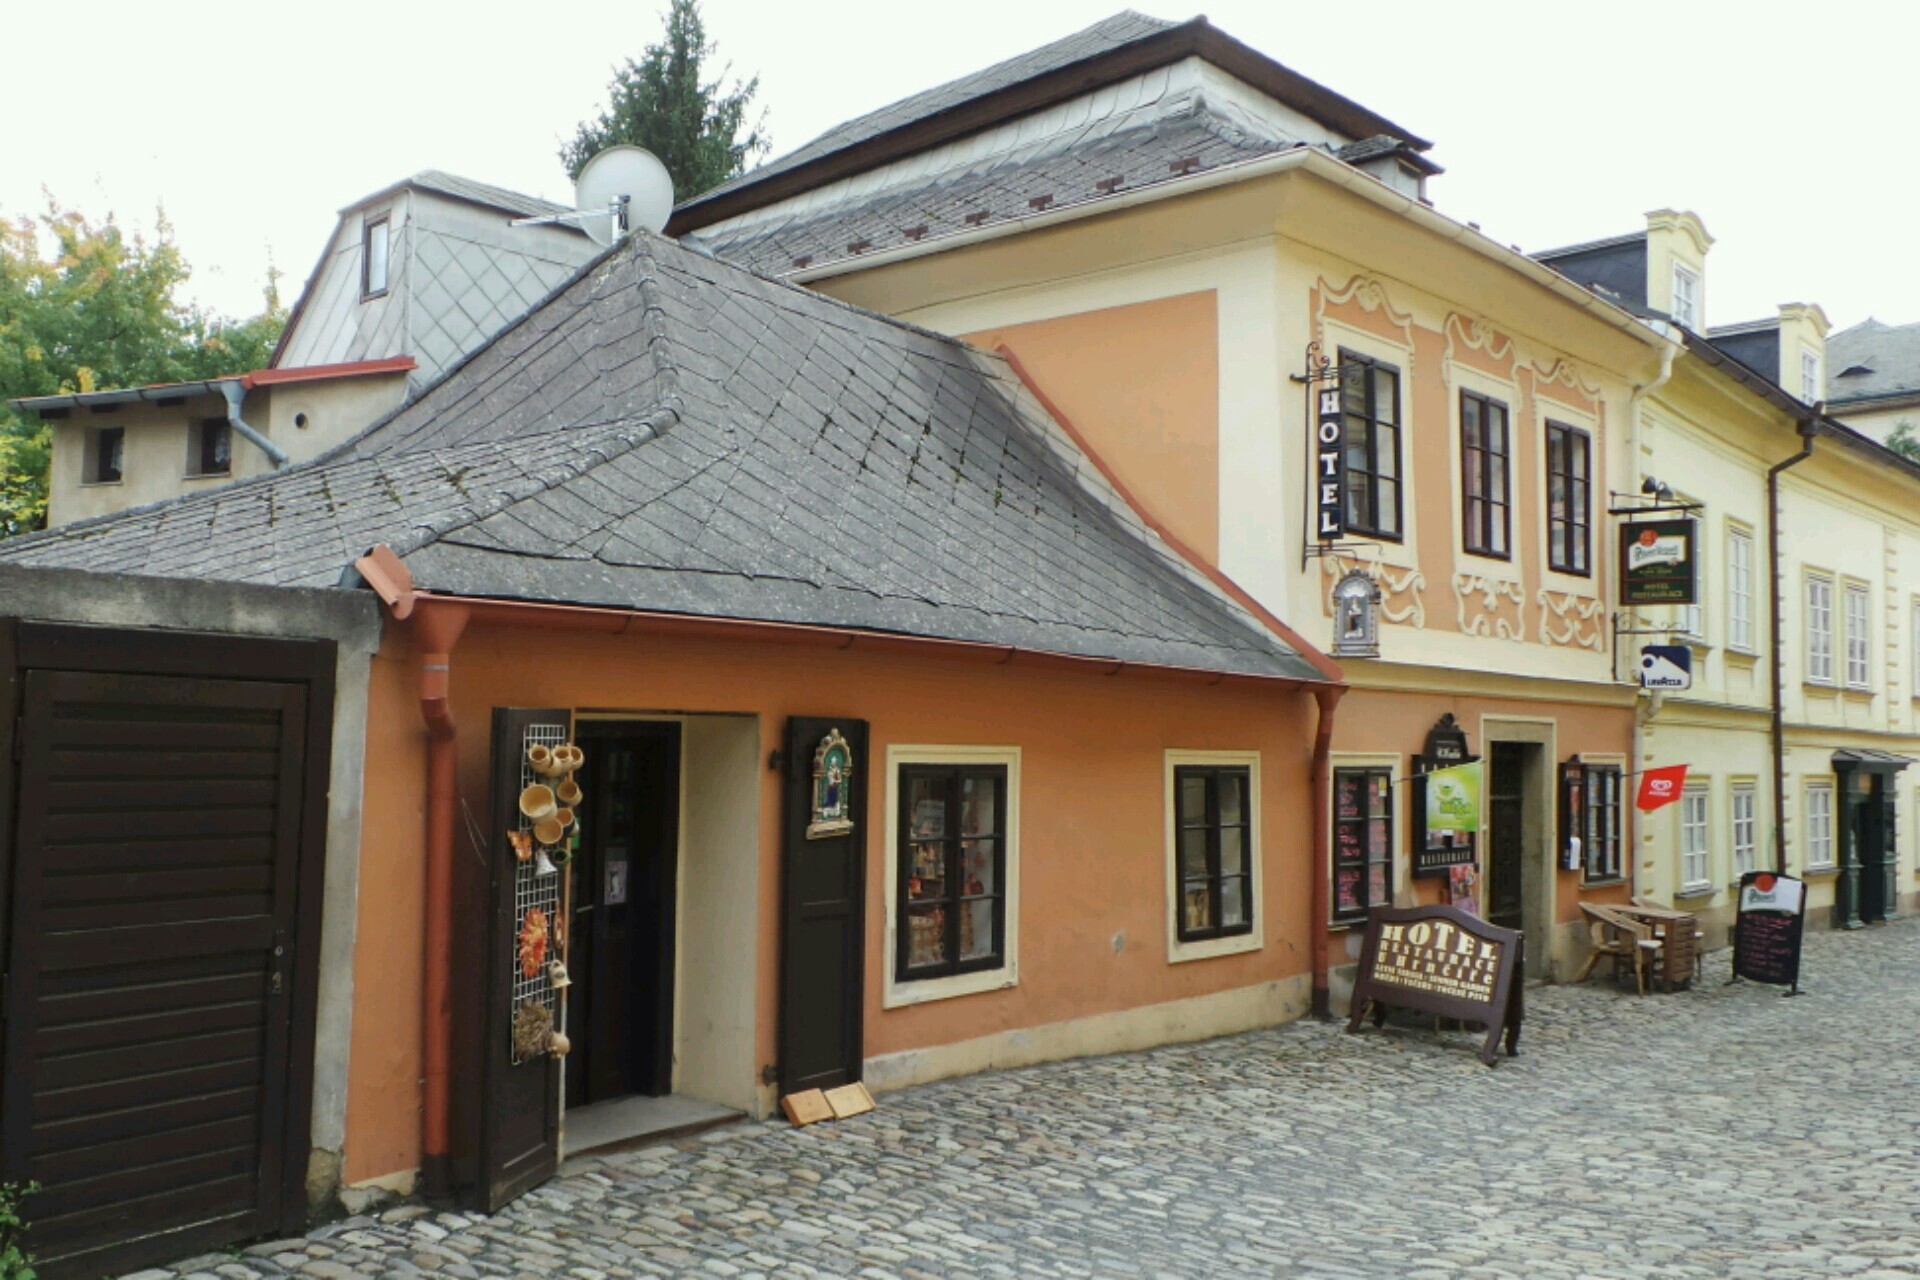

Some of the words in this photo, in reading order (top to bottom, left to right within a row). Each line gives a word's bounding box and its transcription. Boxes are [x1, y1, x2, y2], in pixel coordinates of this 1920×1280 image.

[1319, 389, 1341, 534] HOTEL
[1380, 940, 1495, 973] RESTAURACE
[1381, 922, 1497, 961] HOTEL
